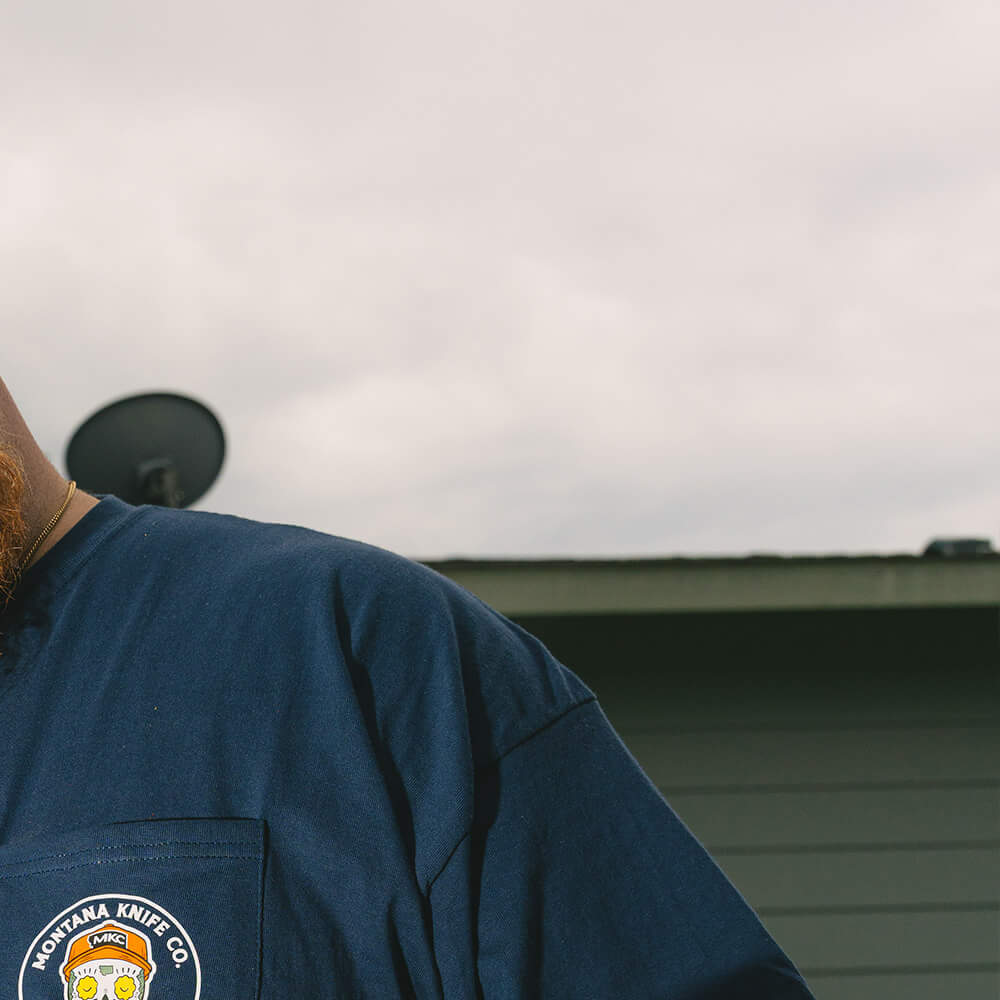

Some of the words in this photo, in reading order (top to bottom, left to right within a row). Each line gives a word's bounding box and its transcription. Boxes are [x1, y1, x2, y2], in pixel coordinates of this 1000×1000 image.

[31, 903, 110, 971] MONTANA
[116, 903, 171, 937] KNIFE
[166, 936, 189, 969] CO.
[92, 932, 126, 946] MKC
